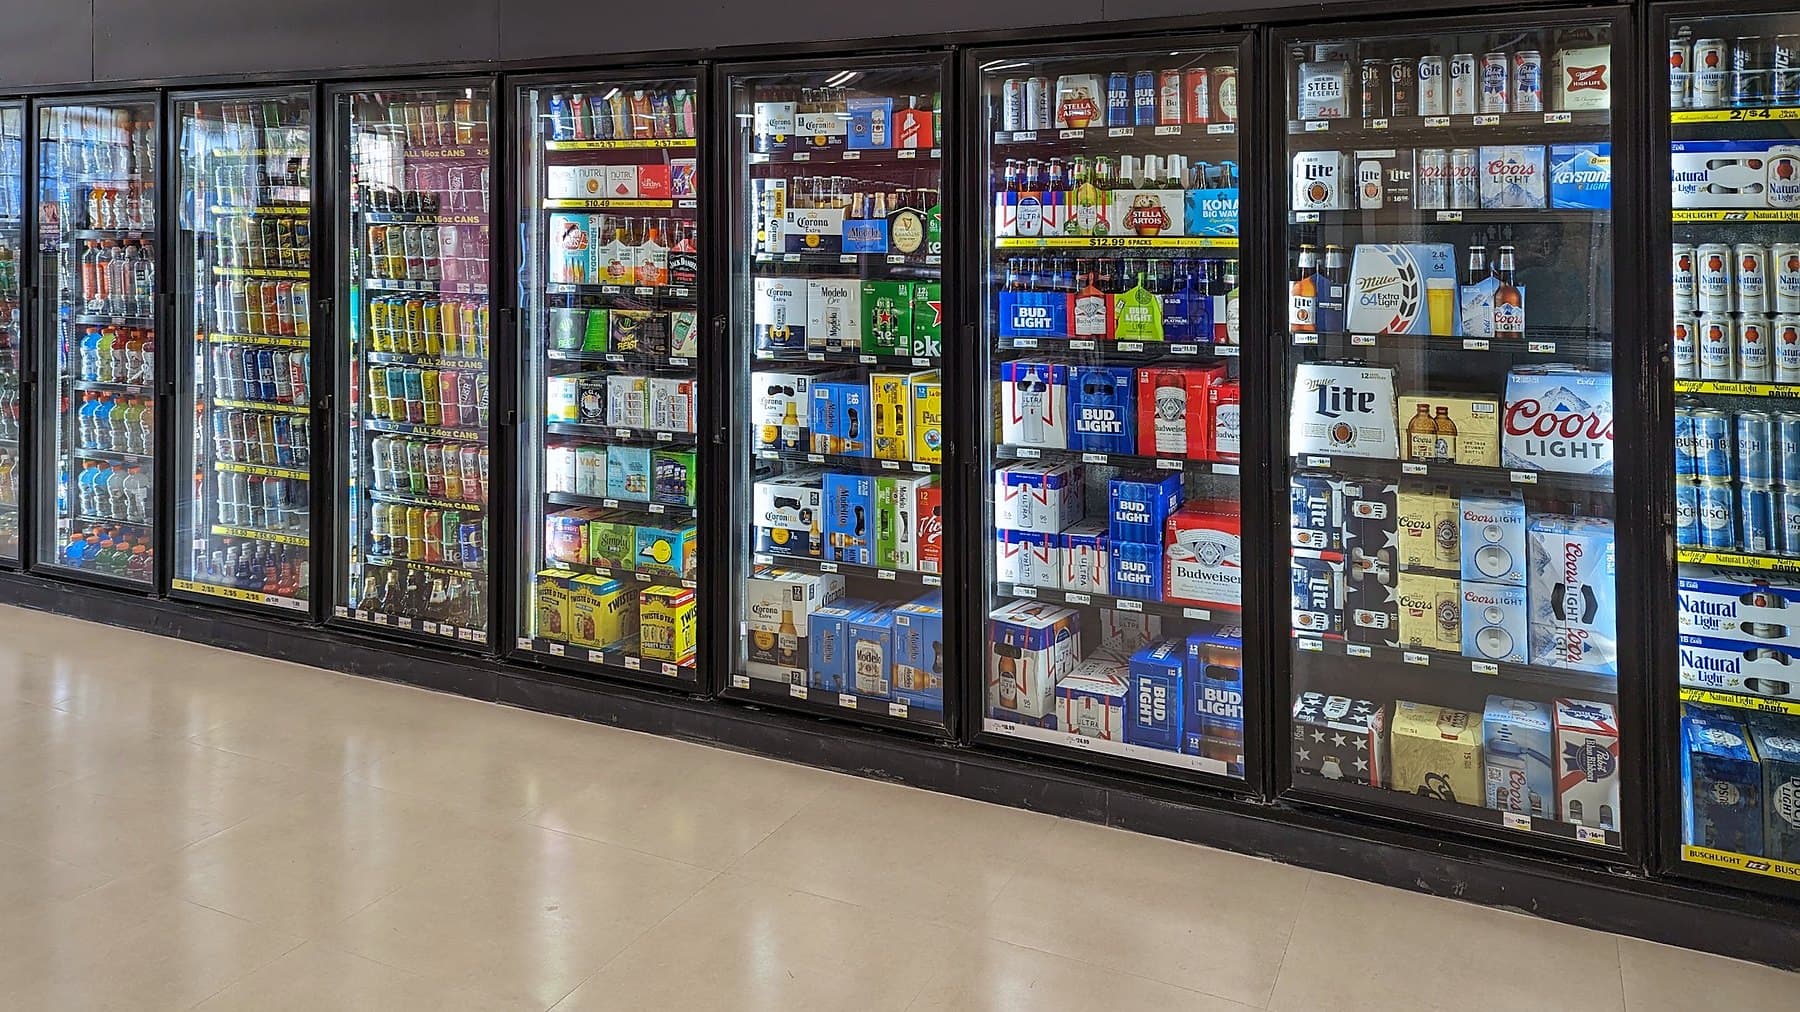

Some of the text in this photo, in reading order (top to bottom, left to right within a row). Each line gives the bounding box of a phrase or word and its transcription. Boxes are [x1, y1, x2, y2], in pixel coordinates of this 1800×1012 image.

[1391, 64, 1412, 82] Colt
[1419, 62, 1441, 80] Colt
[1450, 61, 1471, 78] Colt
[1308, 82, 1340, 91] STEEL
[1063, 102, 1092, 110] STELLA
[1318, 107, 1341, 118] 211
[1730, 109, 1771, 121] 2/$4
[769, 118, 792, 127] Corona
[806, 120, 836, 130] Coronita
[404, 150, 466, 158] ALL 16oz CANS
[1306, 164, 1334, 180] Lite
[1488, 159, 1534, 176] Coors
[1361, 170, 1380, 182] Lite
[1390, 168, 1411, 182] Lite
[1493, 176, 1530, 184] LIGHT
[1553, 170, 1610, 184] KEYSTONE
[1678, 184, 1697, 194] Light
[1778, 194, 1794, 202] Light
[1202, 200, 1239, 212] KONA
[415, 216, 480, 224] ALL 16oz CANS
[1018, 212, 1041, 220] ULTRA
[1133, 210, 1162, 218] STELLA
[1202, 210, 1218, 218] BIG
[1780, 212, 1800, 220] Light
[797, 217, 830, 228] Corona
[1132, 217, 1162, 226] ARTOIS
[1089, 238, 1126, 247] $12.99
[1356, 276, 1400, 292] Miller
[766, 288, 792, 298] Corona
[821, 287, 848, 299] Modelo
[1294, 297, 1312, 308] Lite
[1360, 294, 1378, 306] 64
[1378, 300, 1398, 308] Light
[1018, 307, 1046, 318] BUD
[1128, 306, 1149, 315] BUD
[1013, 317, 1052, 328] LIGHT
[1125, 314, 1152, 322] LIGHT
[1494, 312, 1522, 323] Coors
[1132, 323, 1146, 331] LIME
[1495, 324, 1522, 332] LIGHT
[417, 357, 483, 369] ALL 24oz CANS
[1304, 378, 1336, 391] Miller
[1511, 376, 1521, 384] 12
[1713, 383, 1757, 393] Natural Light
[762, 398, 783, 406] Corona
[851, 393, 859, 404] 18
[1316, 384, 1376, 418] Lite
[1082, 408, 1114, 420] BUD
[1504, 398, 1613, 440] Coors
[1077, 420, 1121, 433] LIGHT
[412, 426, 478, 440] ALL 24oz CANS
[1525, 440, 1605, 460] LIGHT
[580, 458, 600, 466] VMC
[920, 492, 928, 500] 12
[414, 498, 431, 506] ALL
[454, 502, 481, 512] CANS
[1120, 500, 1146, 512] BUD
[1373, 503, 1386, 519] Lite
[765, 512, 797, 522] Coronita
[1116, 511, 1150, 524] LIGHT
[1306, 495, 1328, 528] Lite
[1464, 510, 1523, 524] Coors LIGHT
[1398, 516, 1432, 530] Coors
[601, 532, 628, 549] Simply
[1312, 531, 1328, 548] Lite
[1332, 532, 1340, 540] 12
[1121, 560, 1146, 572] BUD
[1716, 554, 1760, 567] Natural Light
[407, 562, 422, 570] ALL
[446, 569, 473, 578] CANS
[1176, 566, 1240, 584] Budweiser
[1117, 571, 1152, 584] LIGHT
[1566, 542, 1582, 624] Coors LIGHT
[793, 586, 801, 594] 12
[1308, 577, 1329, 610] Lite
[591, 598, 601, 608] TEA
[608, 590, 638, 614] TWISTED
[1400, 596, 1432, 610] Coors
[1464, 592, 1523, 606] Coors LIGHT
[752, 604, 778, 616] Corona
[1678, 595, 1738, 618] Natural
[642, 612, 676, 624] TWISTED TEA
[1313, 612, 1328, 630] Lite
[1334, 614, 1342, 622] 12
[1375, 612, 1386, 629] Lite
[1694, 614, 1720, 631] Light
[856, 650, 881, 664] Modelo
[1681, 650, 1741, 674] Natural
[1698, 671, 1724, 686] Light
[1140, 677, 1152, 726] LIGHT
[1204, 688, 1241, 705] BUD
[1710, 692, 1754, 706] Natural Light
[1154, 686, 1166, 721] BUD
[1198, 700, 1243, 718] LIGHT
[1758, 704, 1789, 714] DADDY
[1586, 740, 1596, 782] Blue Ribbon
[1597, 750, 1610, 773] Pabst
[1510, 770, 1526, 812] Coors
[1782, 786, 1792, 820] LIGHT
